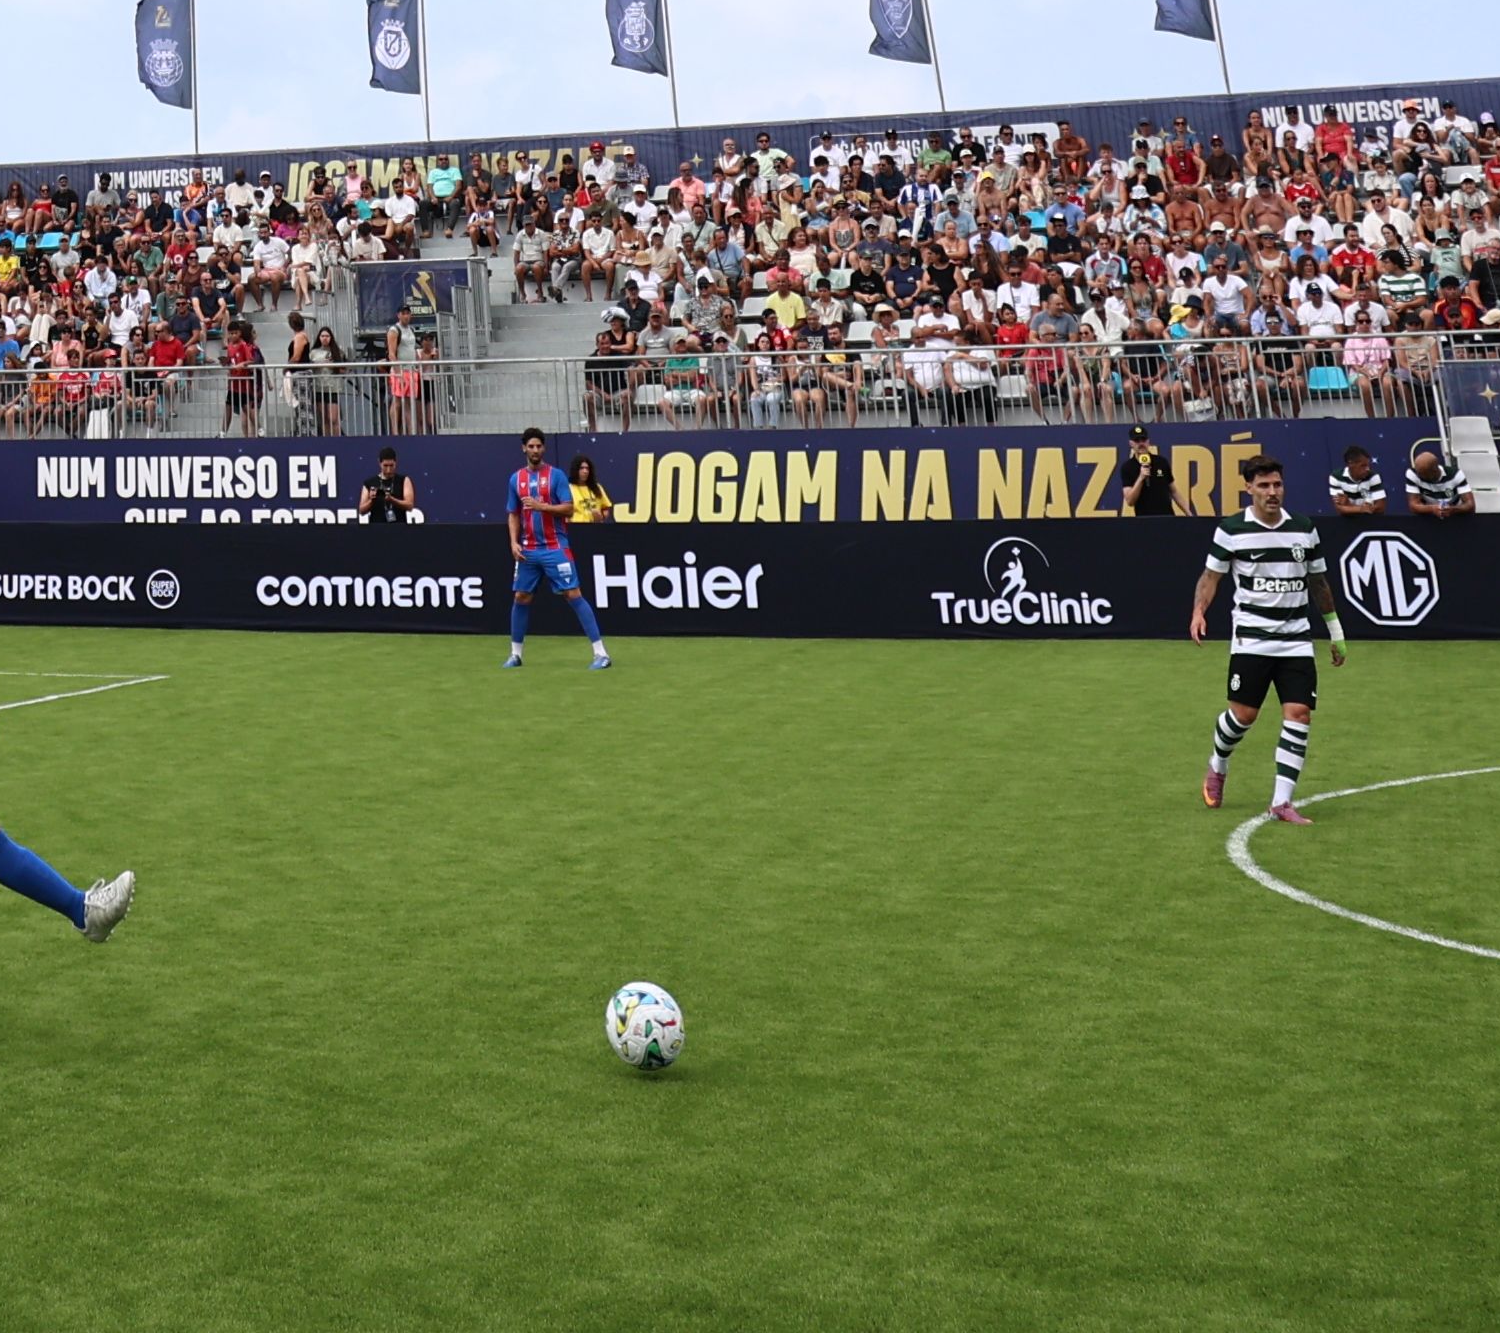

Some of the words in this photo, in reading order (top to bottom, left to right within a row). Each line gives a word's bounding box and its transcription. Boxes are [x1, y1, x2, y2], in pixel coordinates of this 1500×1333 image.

[1261, 105, 1305, 129] NU
[38, 456, 105, 498] NUM
[116, 456, 277, 499] UNIVERSO
[289, 455, 337, 498] EM
[613, 450, 838, 523] JOGAM
[861, 448, 952, 522] NA
[977, 431, 1263, 521] NAZRÉ
[67, 575, 136, 601] BOCK
[150, 580, 175, 590] SUPER
[152, 588, 174, 598] BOCK
[592, 551, 764, 609] Haier
[1253, 577, 1305, 593] Betano
[1349, 540, 1429, 617] MG
[930, 592, 1113, 625] TrueClinic
